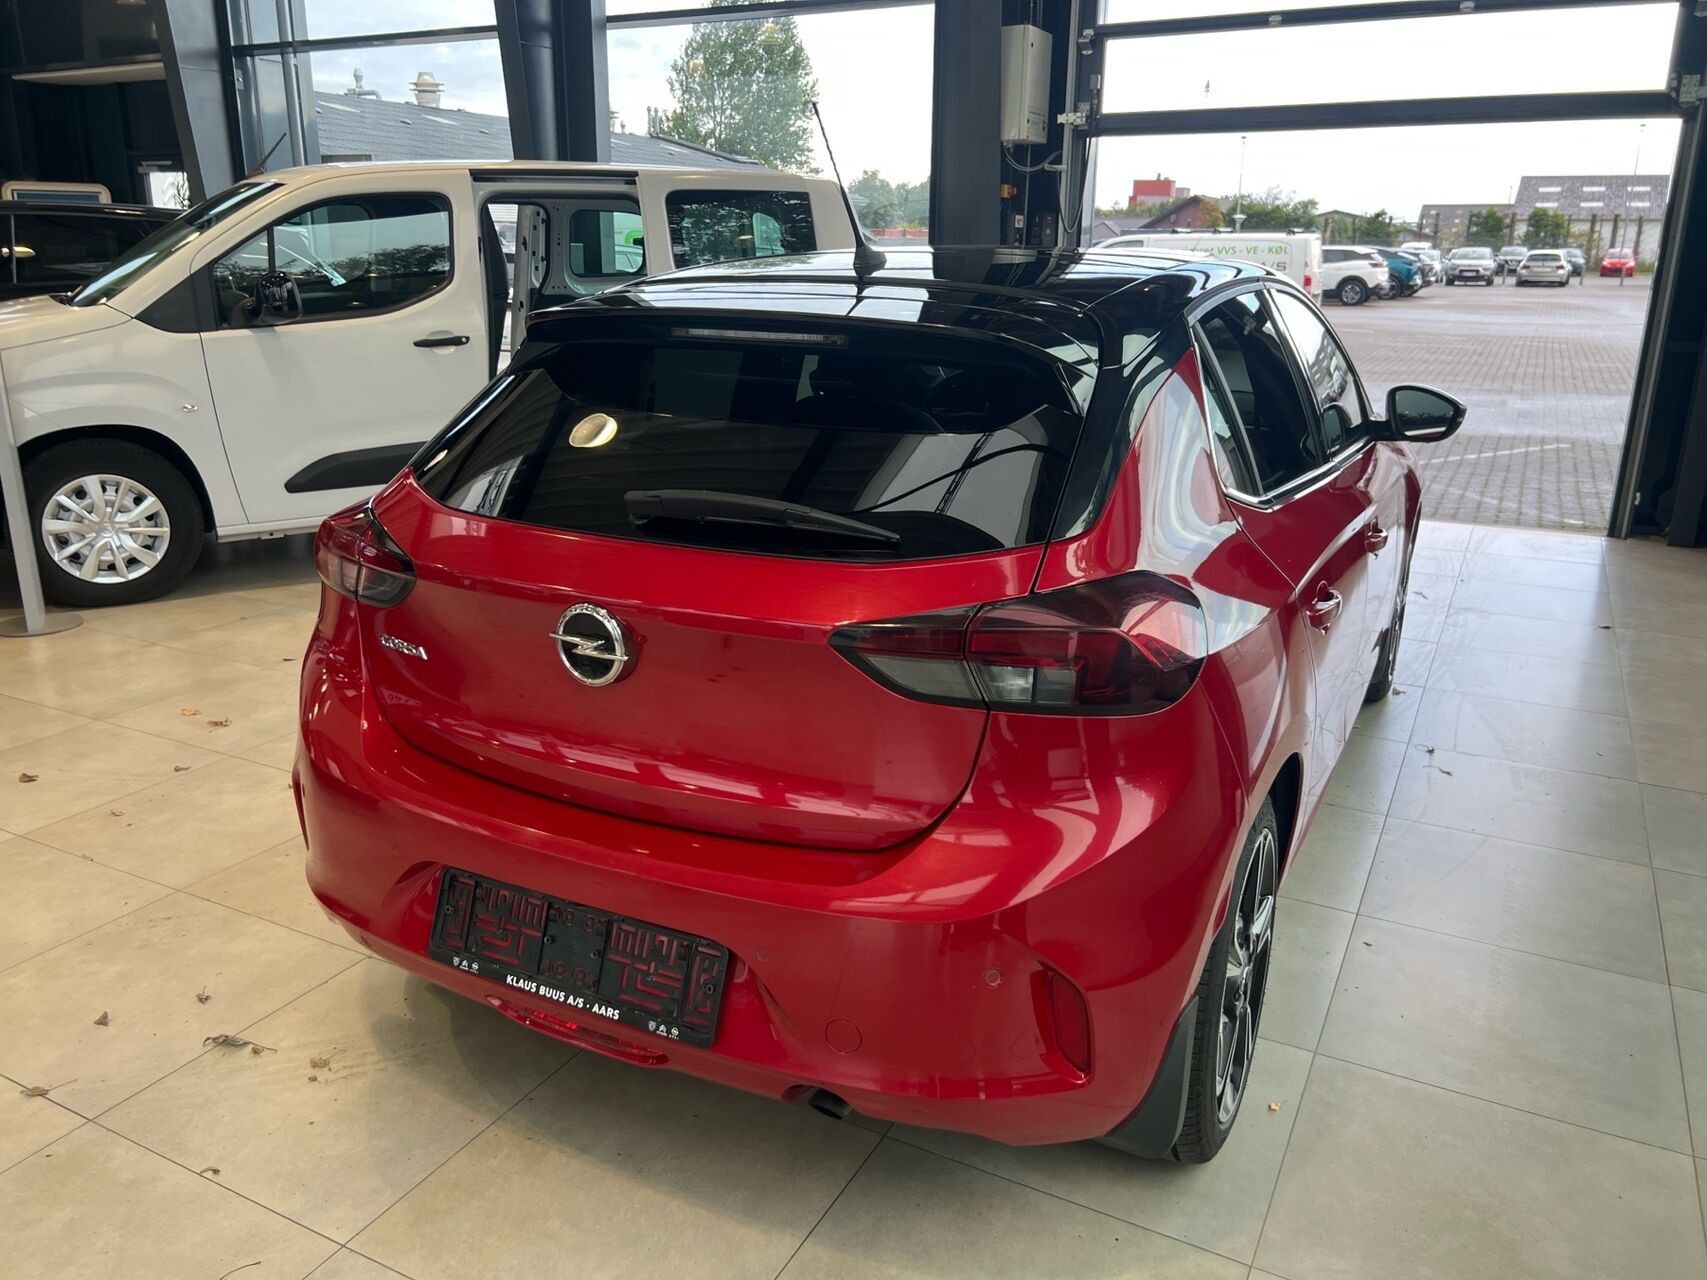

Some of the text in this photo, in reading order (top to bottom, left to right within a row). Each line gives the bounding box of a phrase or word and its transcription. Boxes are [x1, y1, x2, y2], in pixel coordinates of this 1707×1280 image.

[1216, 245, 1237, 255] VVS
[1245, 245, 1259, 254] VE
[1267, 245, 1289, 255] KØL
[506, 974, 538, 993] KLAUS
[539, 985, 566, 1003] BUUS
[566, 995, 585, 1009] A/S
[592, 1003, 620, 1020] AARS
